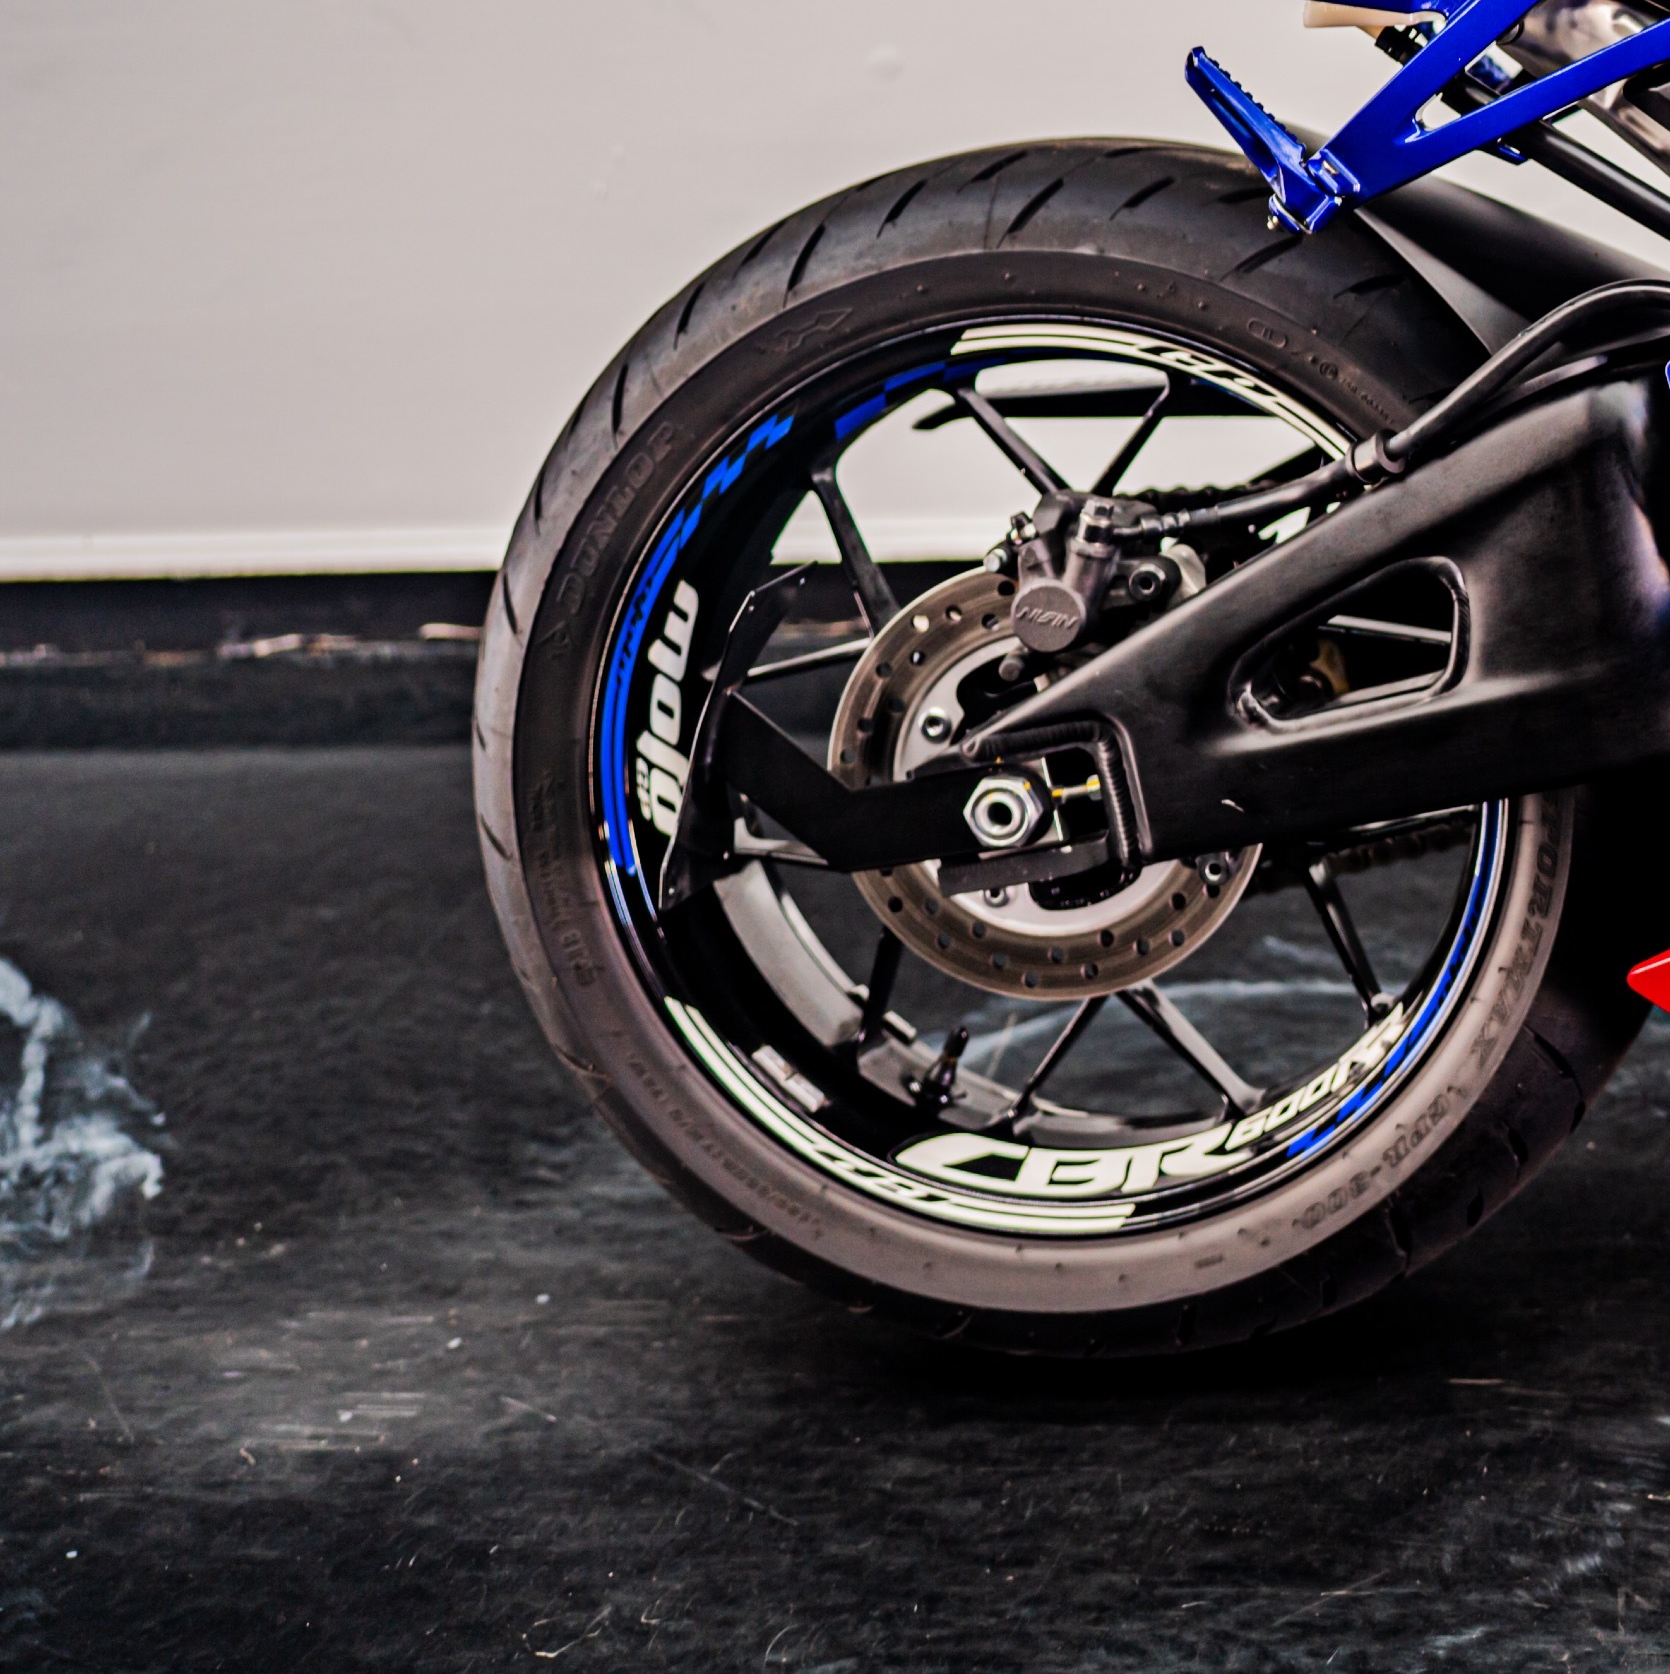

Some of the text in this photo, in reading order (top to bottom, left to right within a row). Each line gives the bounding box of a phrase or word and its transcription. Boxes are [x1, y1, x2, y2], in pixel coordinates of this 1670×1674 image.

[551, 417, 686, 616] DUNLOP
[896, 1123, 1253, 1198] CBR
[1294, 1092, 1456, 1233] GPR-300
